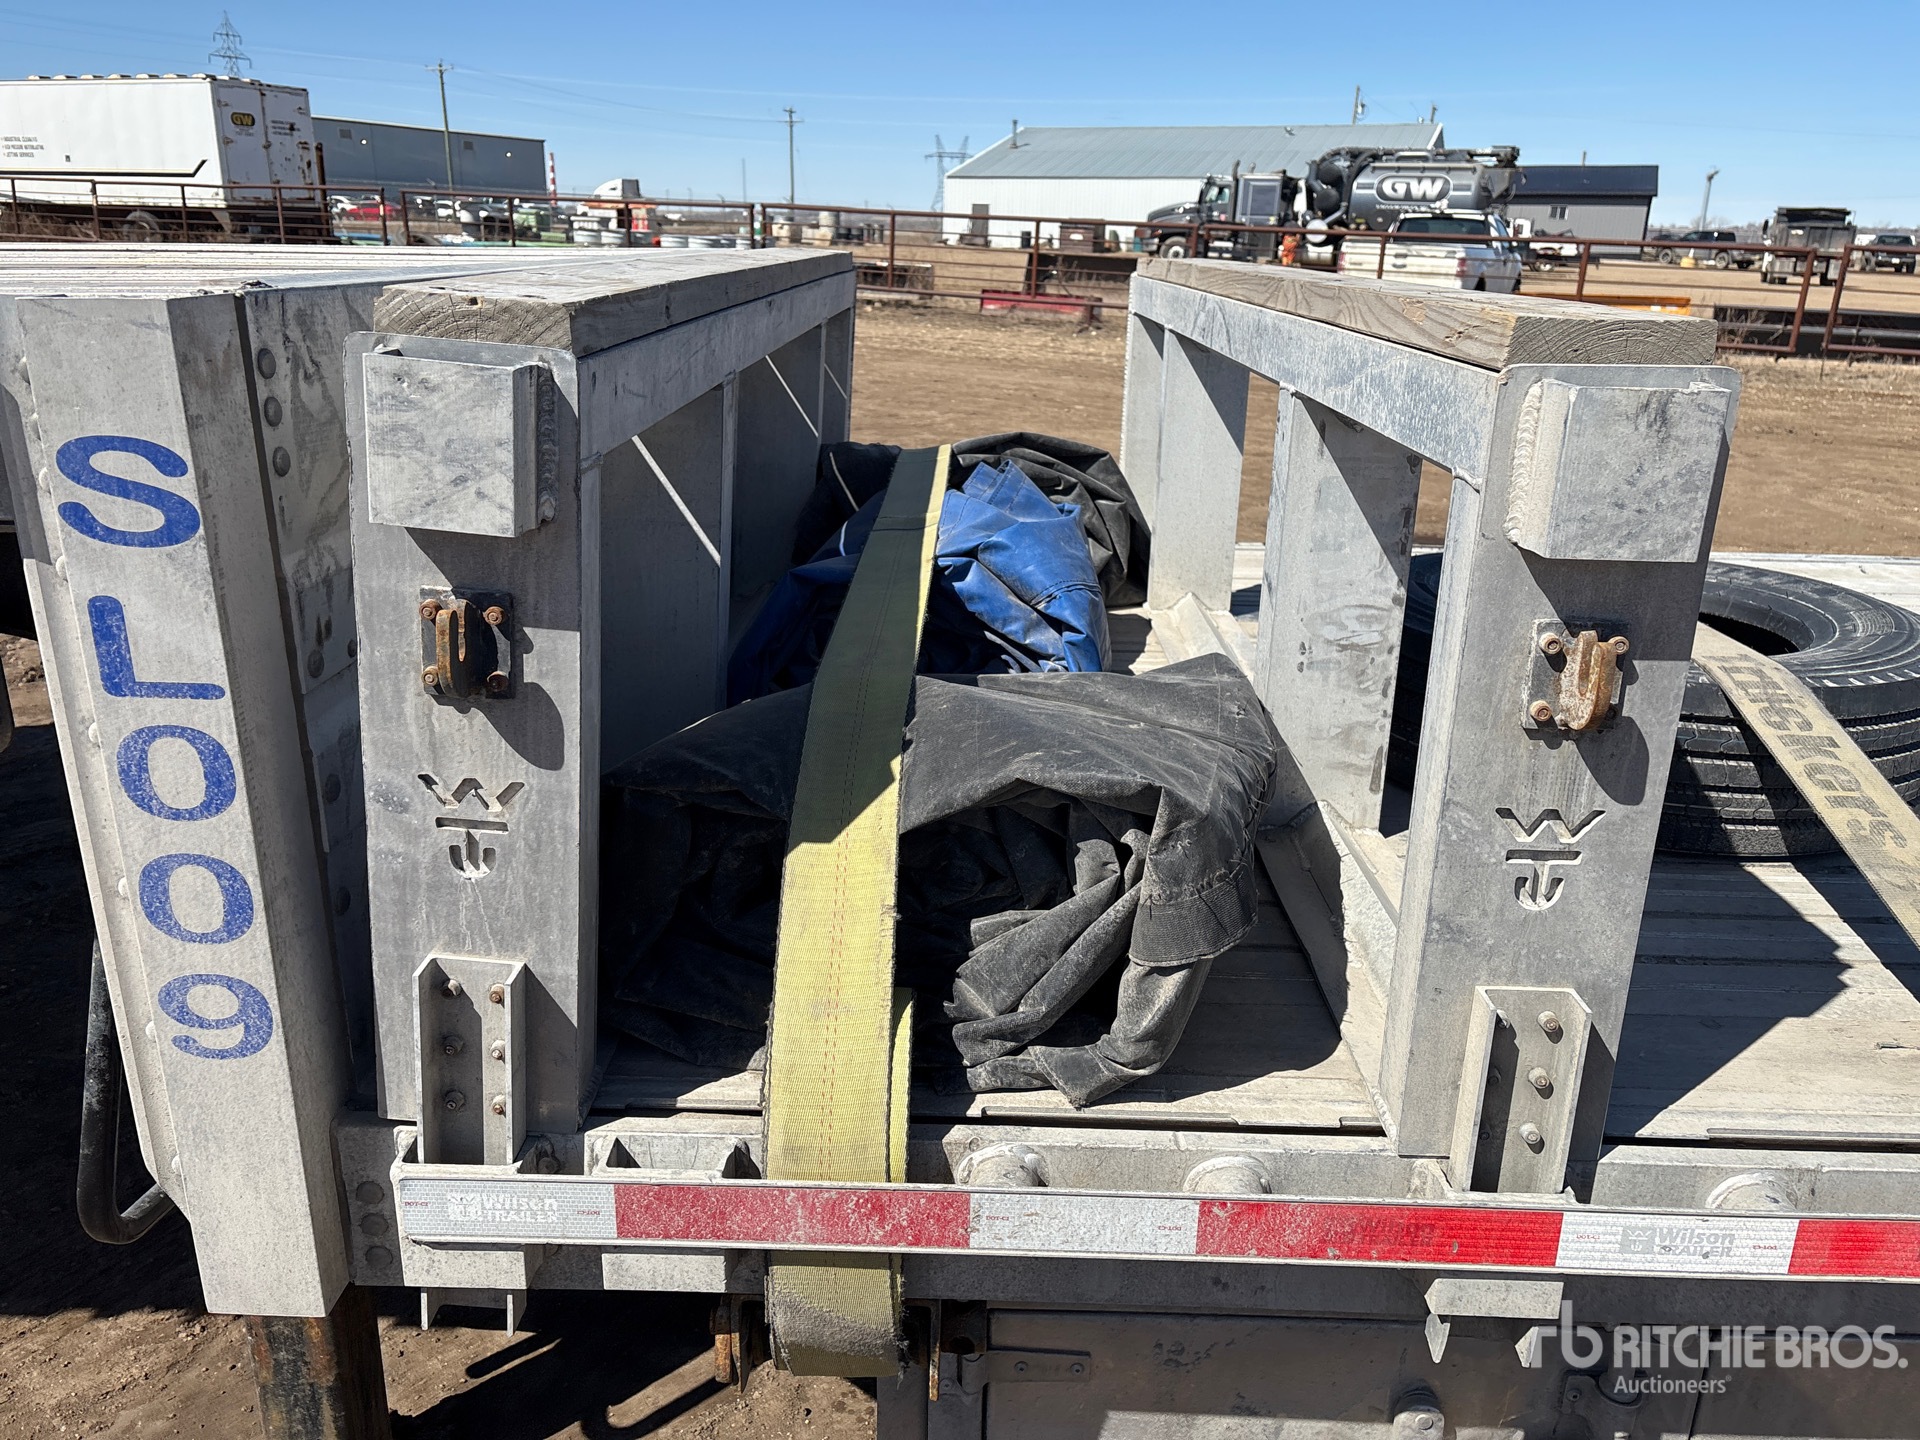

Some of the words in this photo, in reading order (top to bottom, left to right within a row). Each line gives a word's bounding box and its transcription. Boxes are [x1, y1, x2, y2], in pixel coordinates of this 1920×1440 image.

[1381, 176, 1446, 201] GW
[481, 1192, 558, 1211] Wilson
[1657, 1227, 1736, 1246] Wilson
